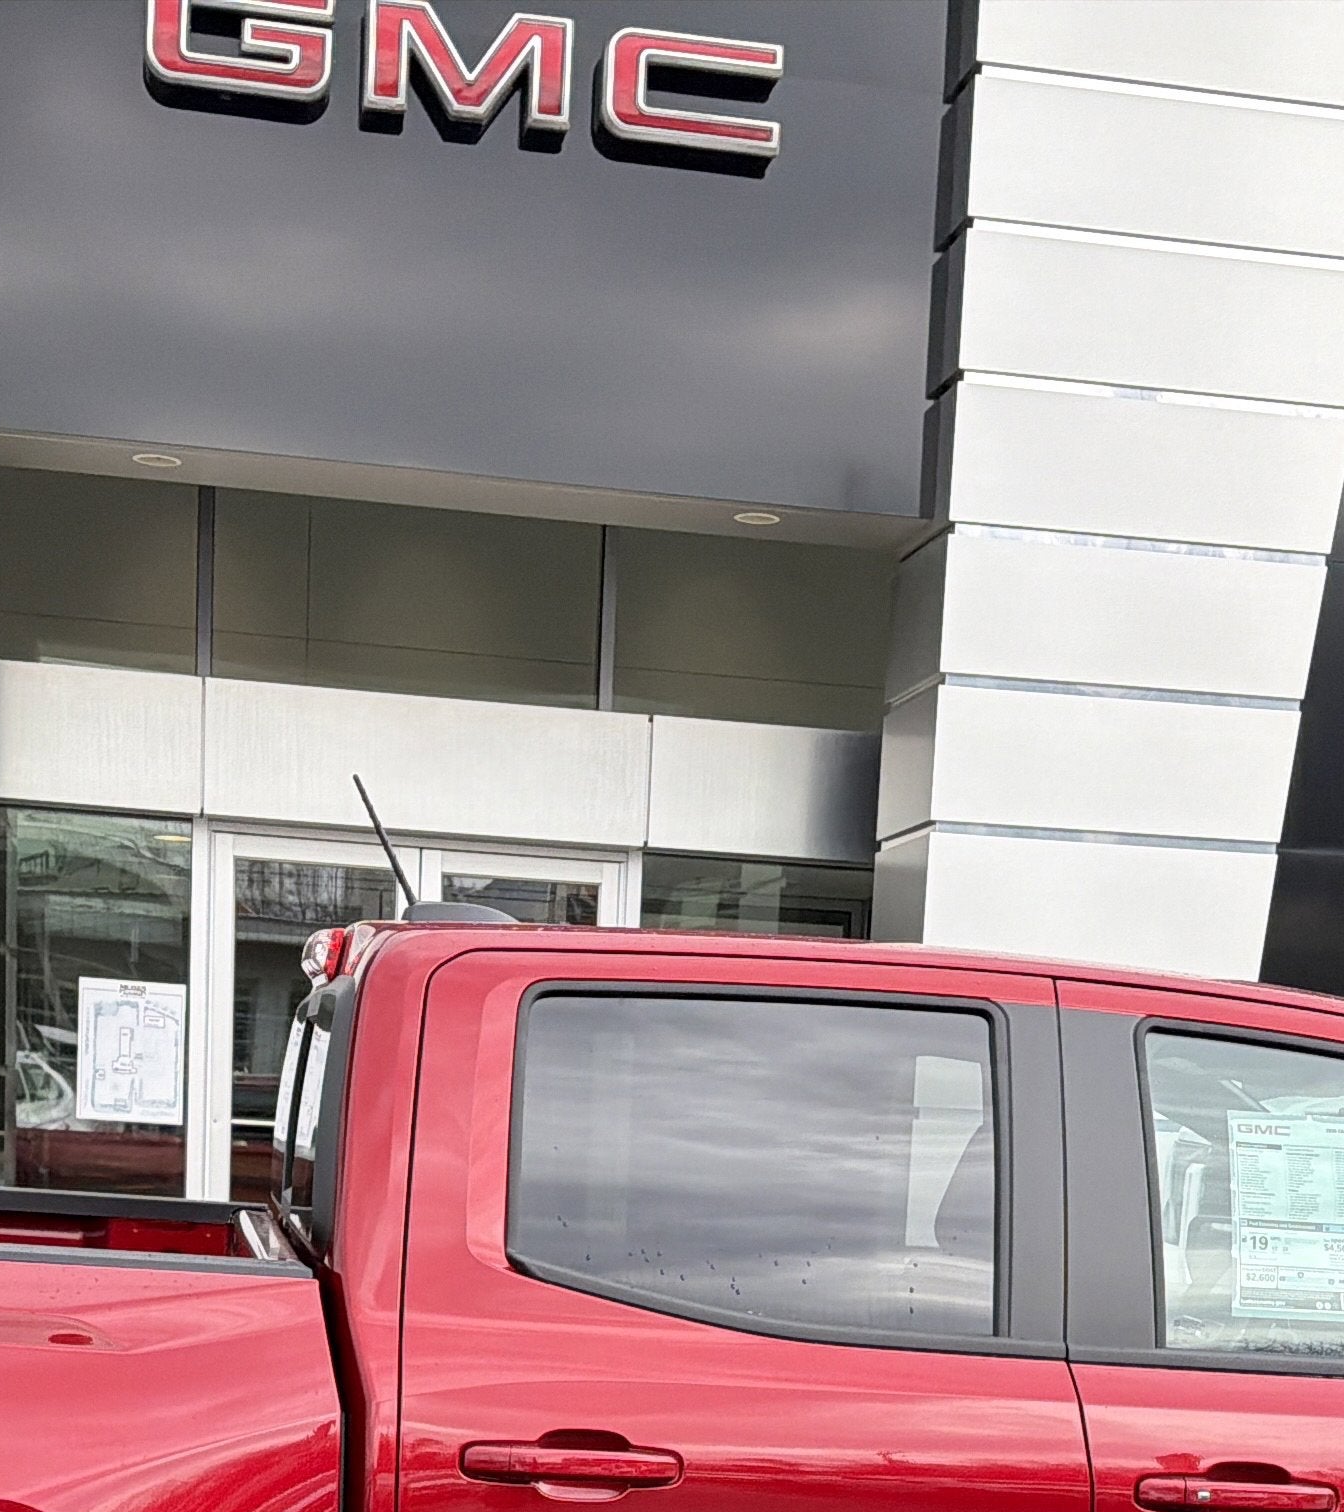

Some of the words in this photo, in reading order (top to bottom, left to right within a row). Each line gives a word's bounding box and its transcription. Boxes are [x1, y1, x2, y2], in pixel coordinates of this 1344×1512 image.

[145, 0, 784, 156] GMC
[1237, 1123, 1291, 1136] GMC
[1250, 1235, 1268, 1251] 19
